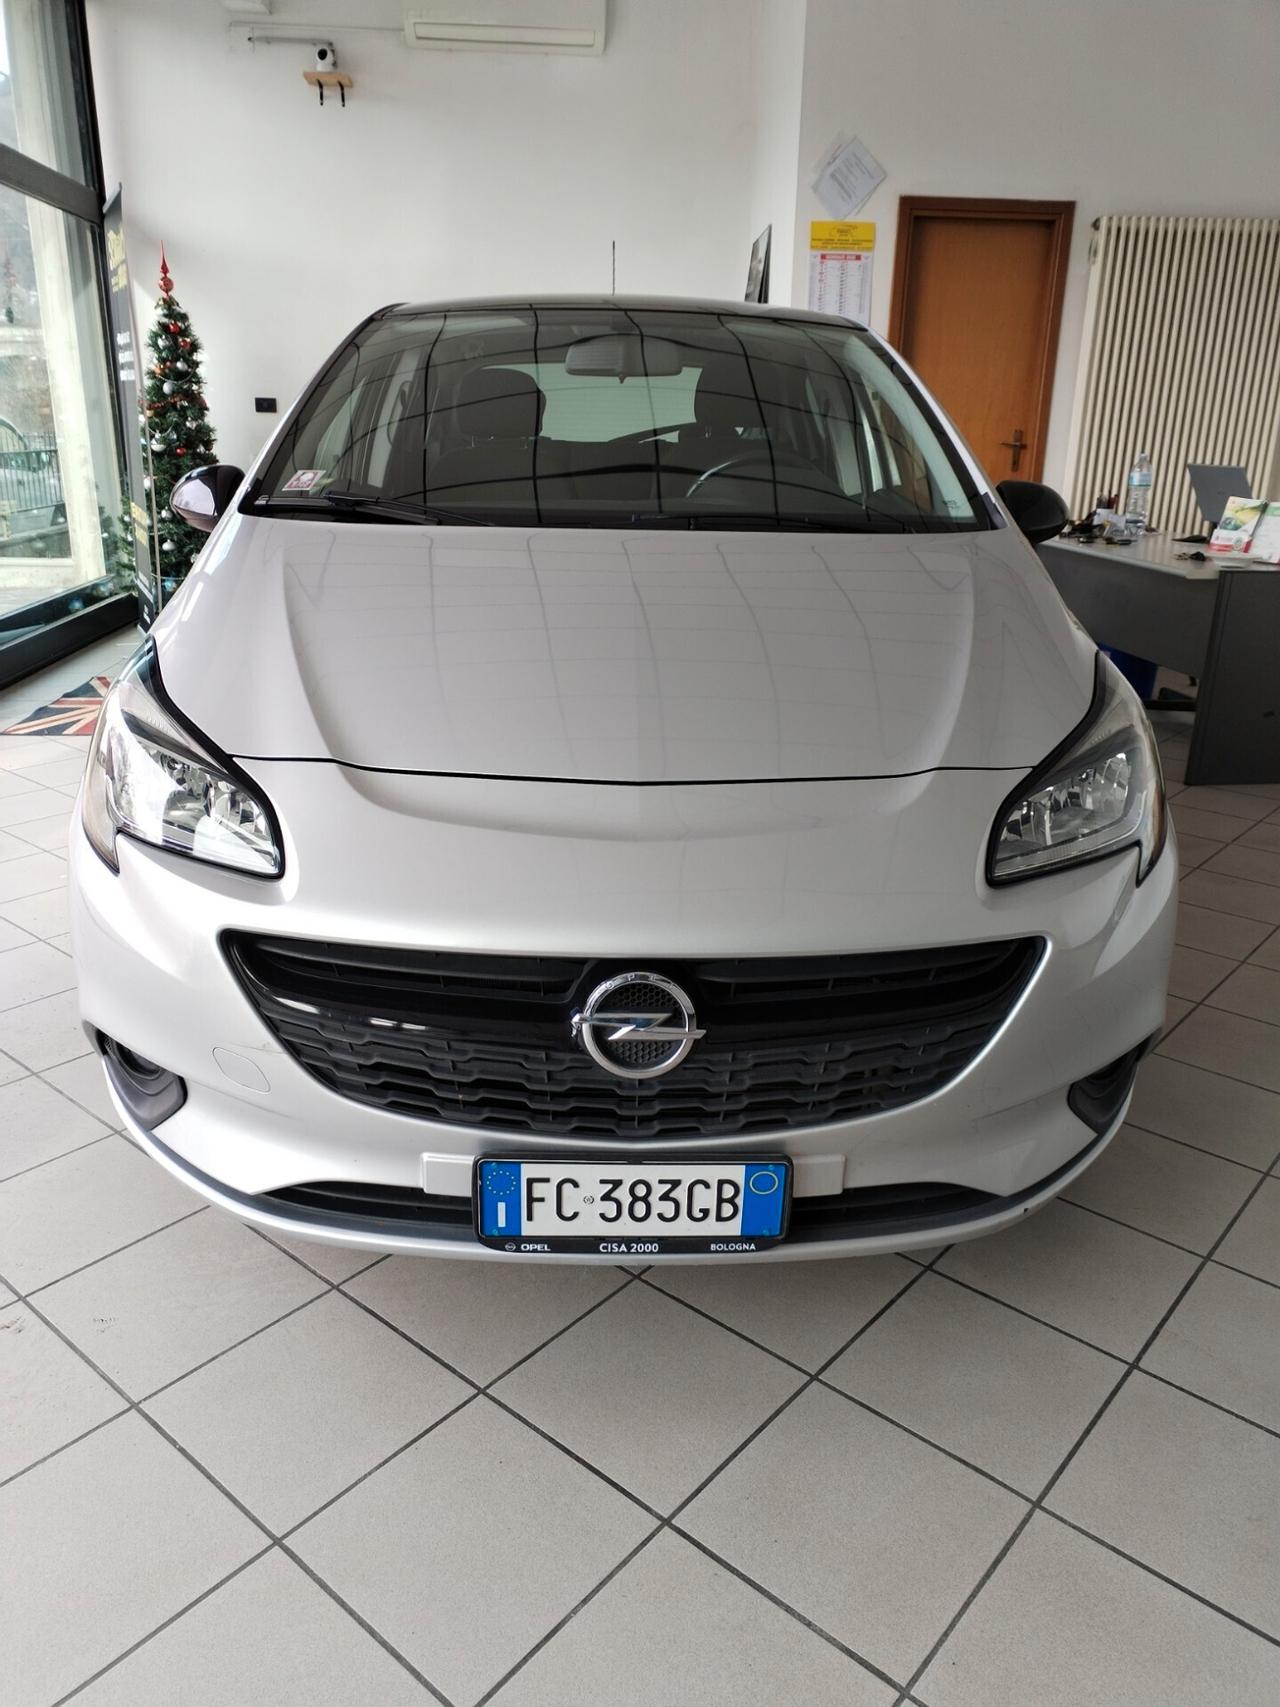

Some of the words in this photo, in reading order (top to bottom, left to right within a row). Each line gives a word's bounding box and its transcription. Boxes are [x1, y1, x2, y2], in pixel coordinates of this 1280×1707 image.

[526, 1177, 580, 1222] FC
[599, 1178, 741, 1223] 383GB
[497, 1202, 506, 1228] I
[520, 1243, 551, 1252] OPEL
[599, 1242, 628, 1253] CISA
[630, 1242, 659, 1253] 2000
[710, 1243, 757, 1251] BOLOGNA
